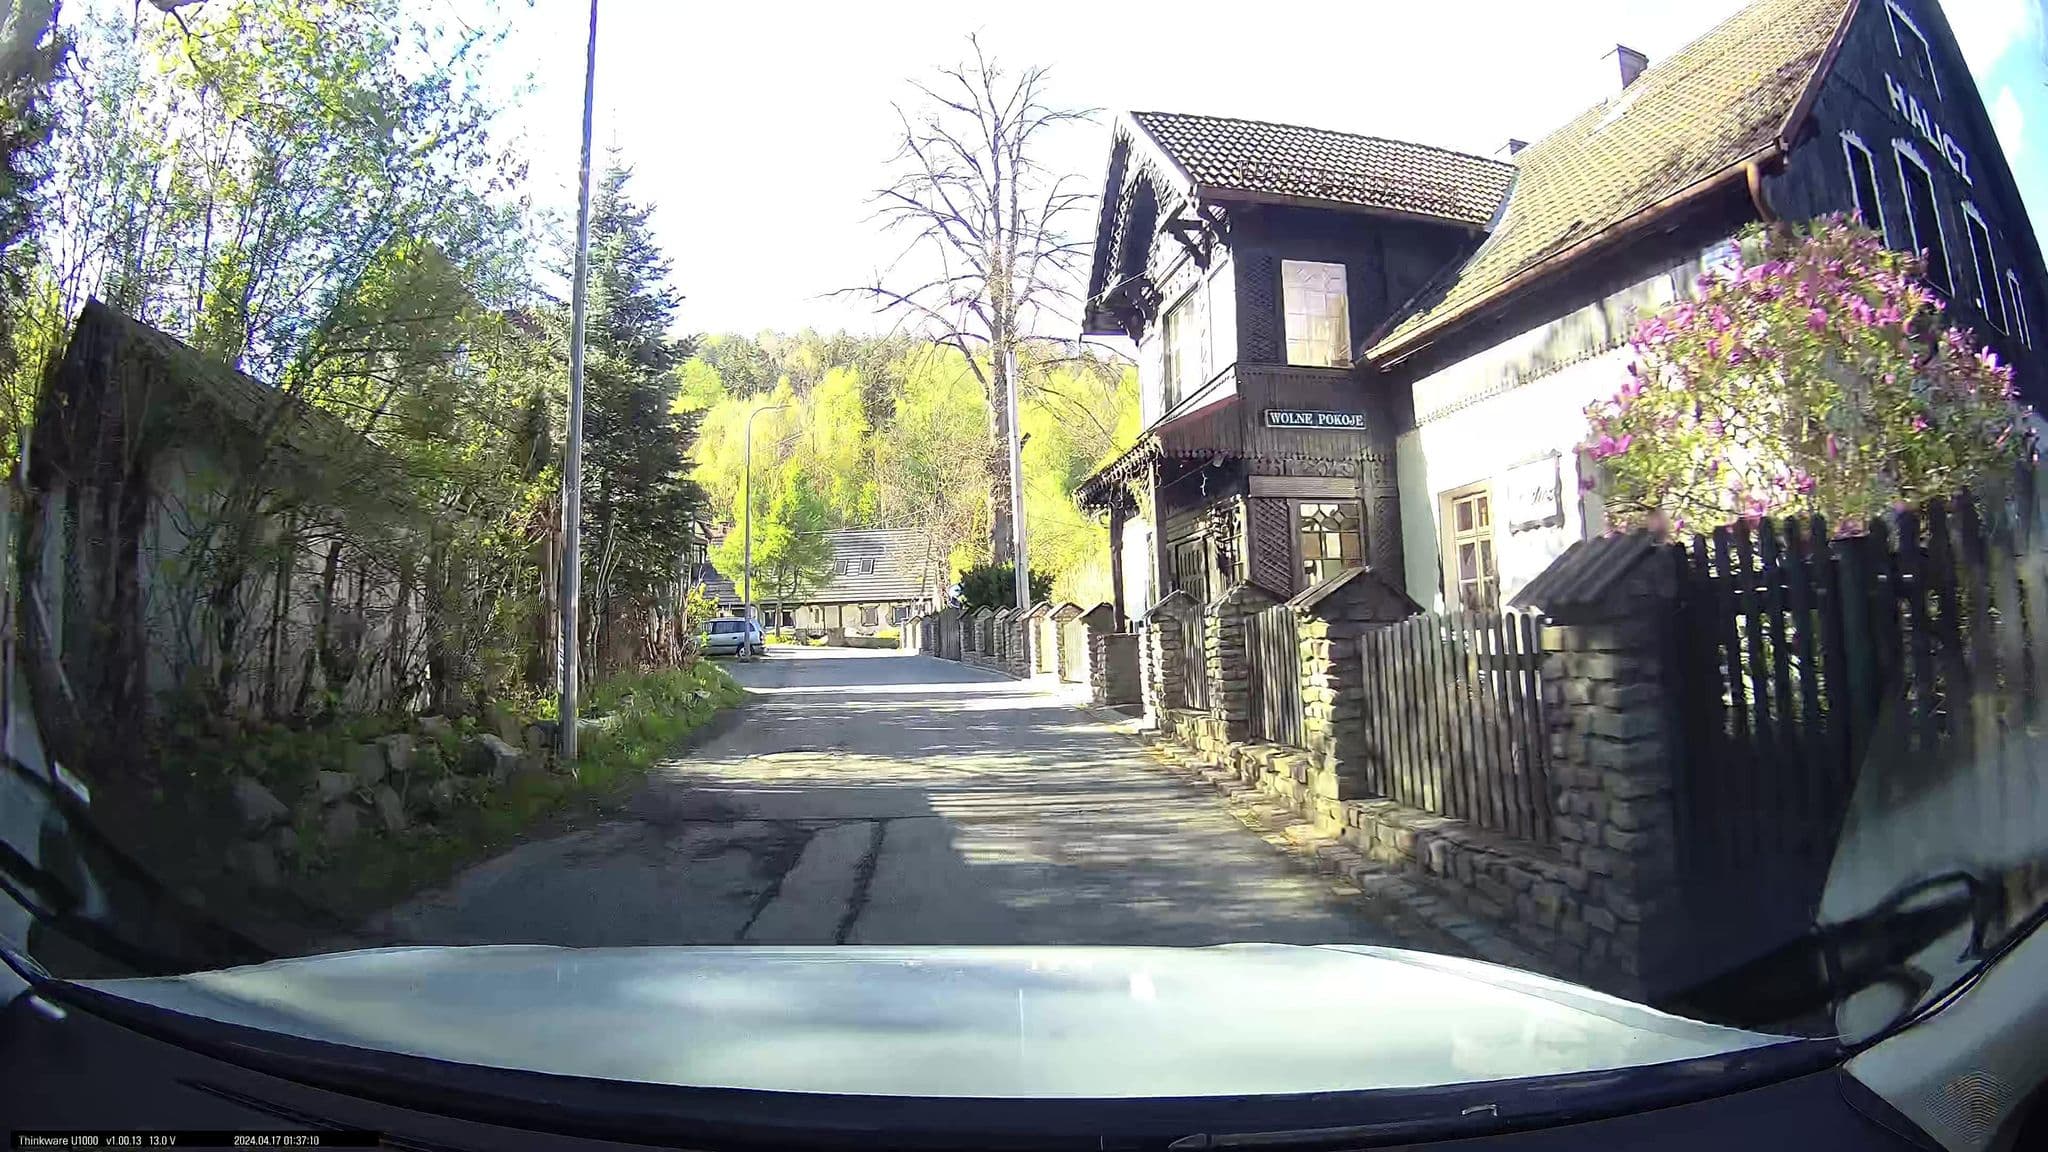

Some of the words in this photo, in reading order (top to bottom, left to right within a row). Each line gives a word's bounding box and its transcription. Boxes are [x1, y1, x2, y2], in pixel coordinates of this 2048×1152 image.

[1884, 71, 1973, 188] HALICZ
[1269, 412, 1313, 425] WOLNE
[1318, 413, 1364, 426] POKOJE
